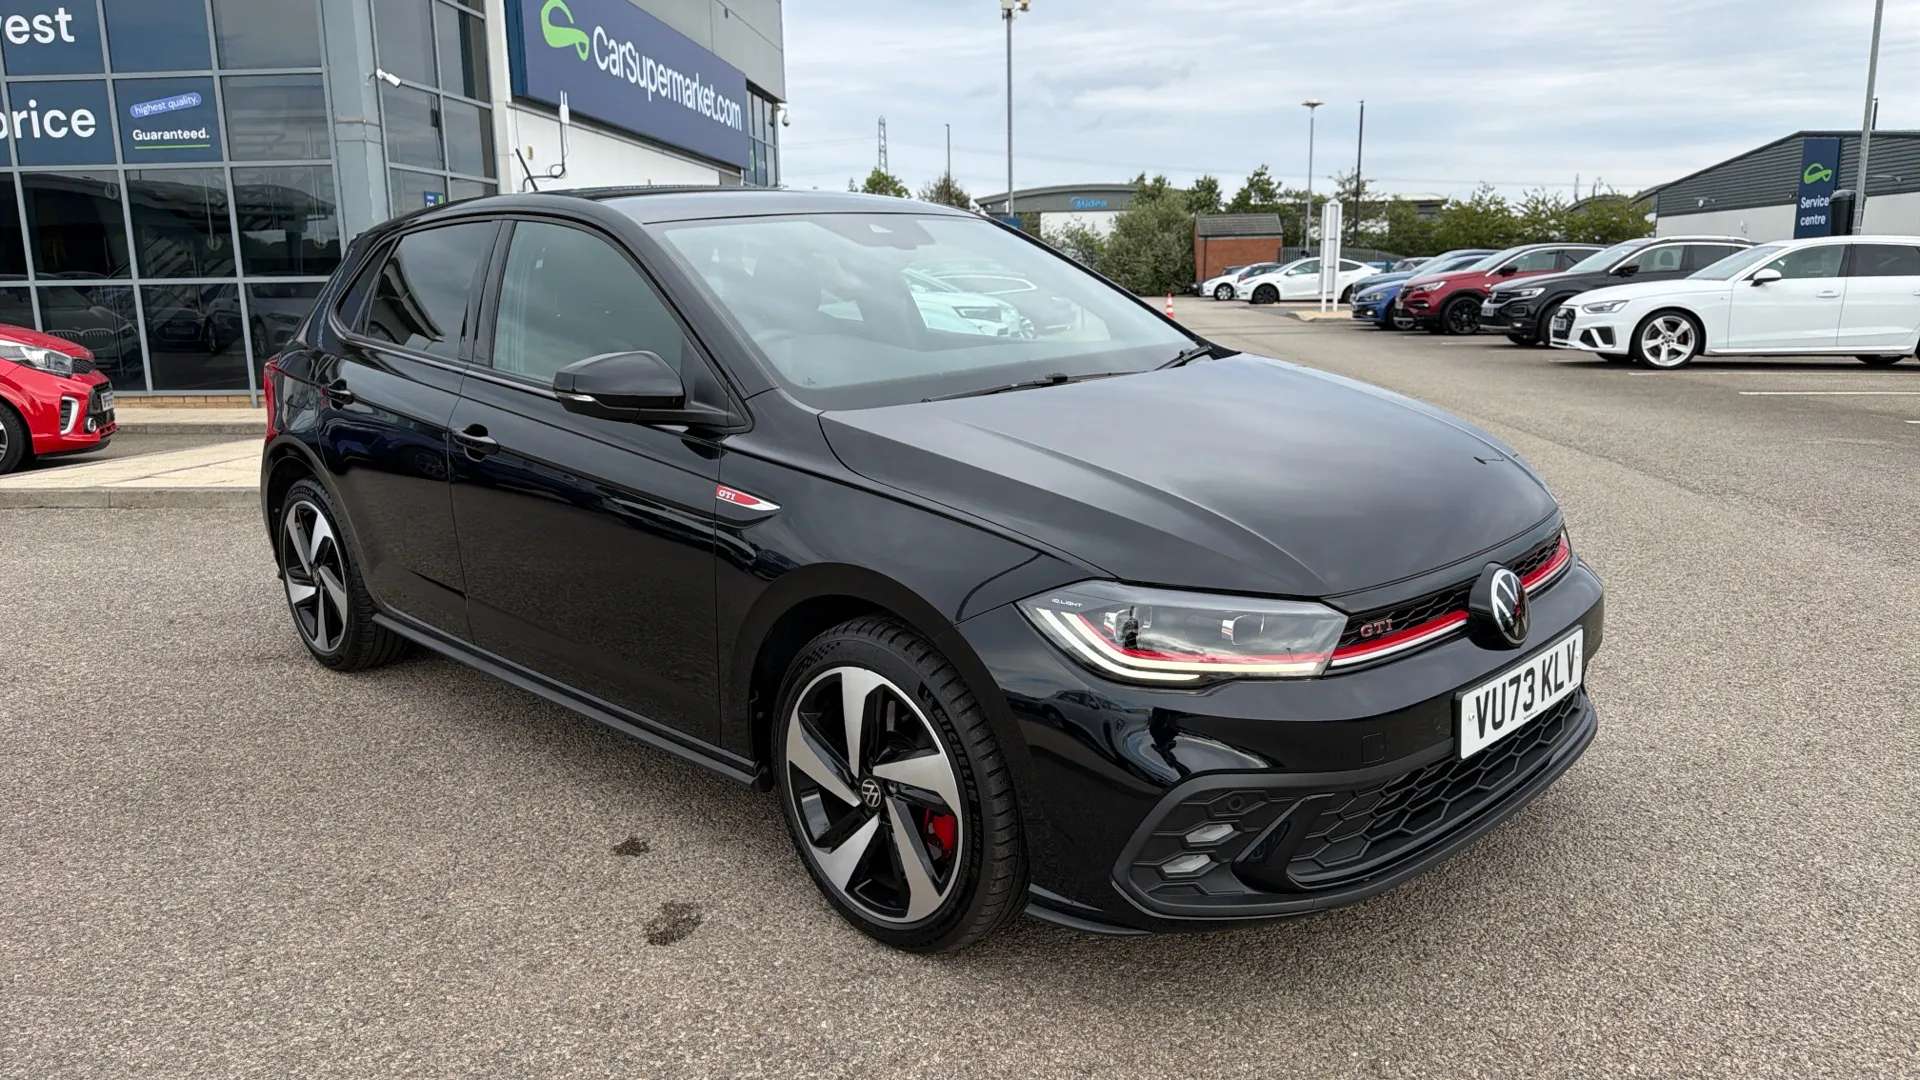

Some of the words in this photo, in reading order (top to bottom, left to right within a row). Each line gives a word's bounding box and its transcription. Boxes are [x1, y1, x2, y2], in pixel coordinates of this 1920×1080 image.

[0, 7, 75, 45] est
[593, 26, 742, 131] CarSupermarket.com
[134, 102, 166, 115] highest
[168, 96, 200, 110] quality.
[132, 128, 210, 141] Guaranteed.
[1800, 195, 1830, 209] Service
[1800, 214, 1826, 226] centre
[718, 489, 736, 500] GTI
[1360, 618, 1393, 638] GTI
[1475, 667, 1535, 740] VU73
[1541, 639, 1577, 702] KLV
